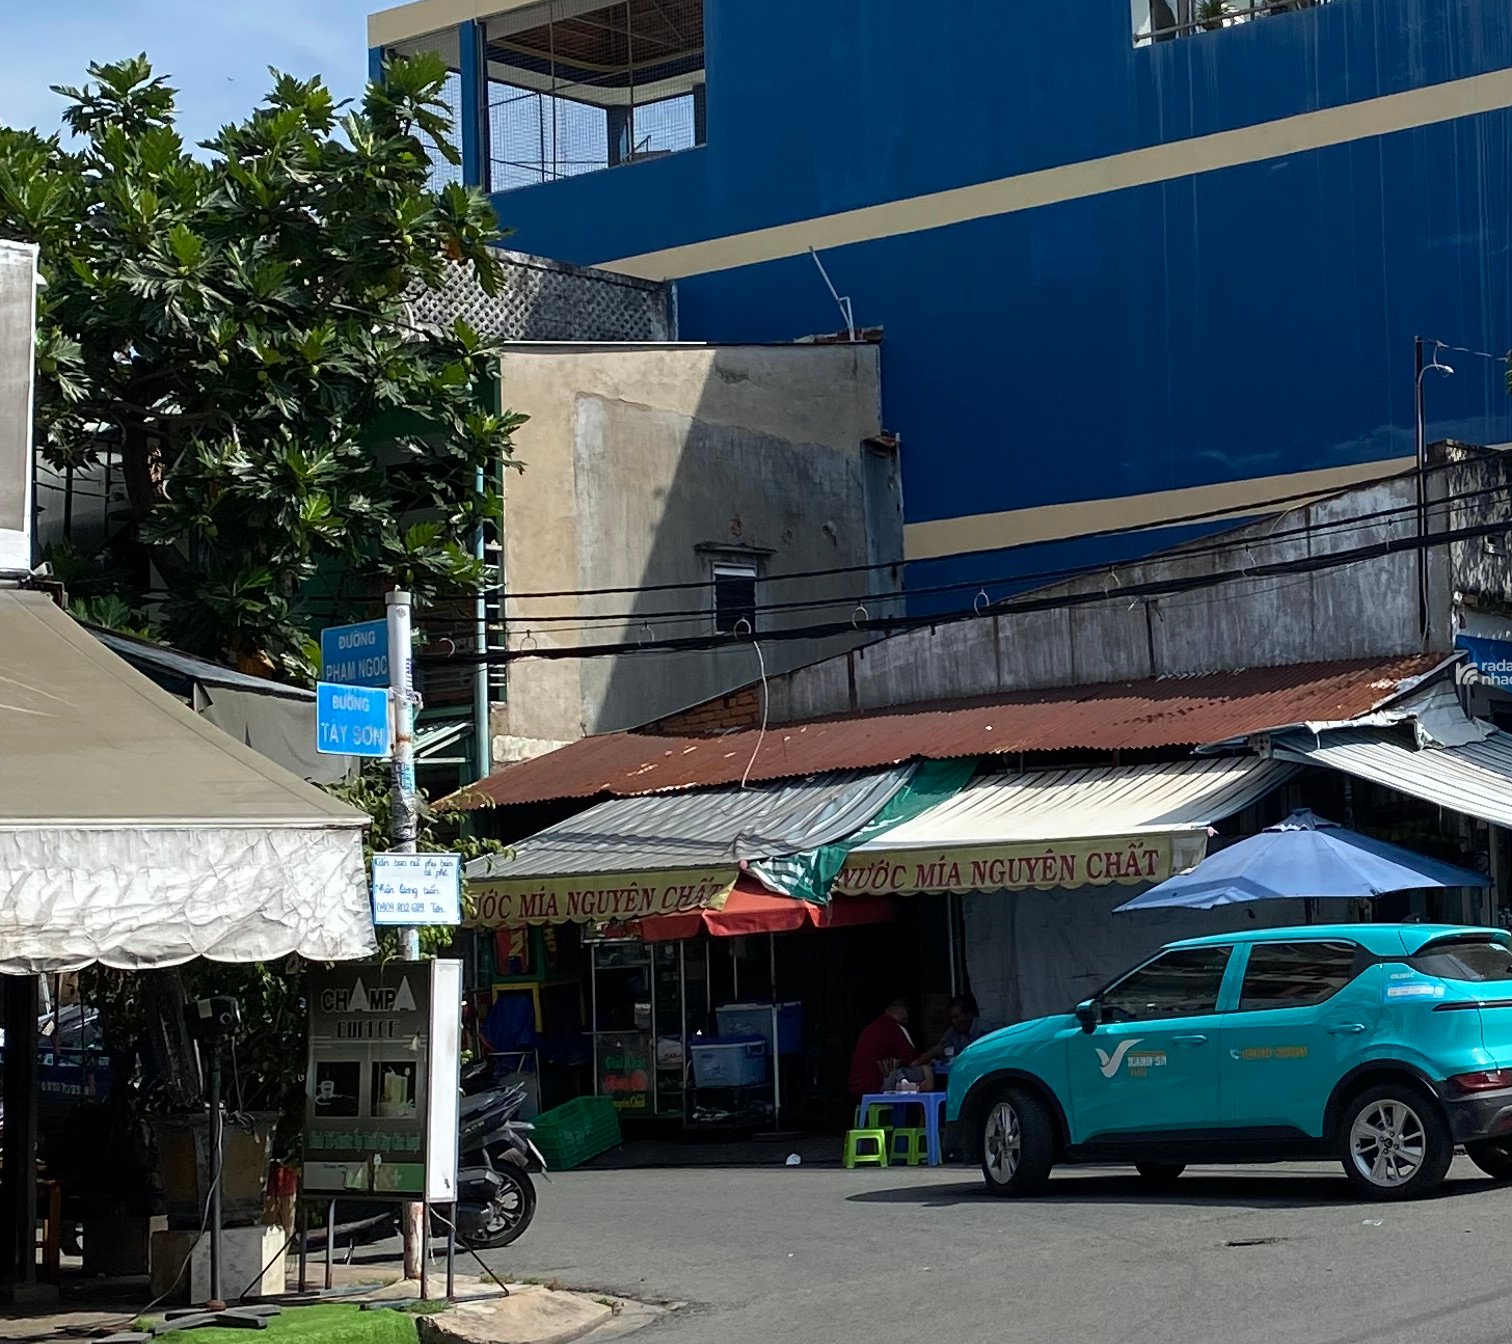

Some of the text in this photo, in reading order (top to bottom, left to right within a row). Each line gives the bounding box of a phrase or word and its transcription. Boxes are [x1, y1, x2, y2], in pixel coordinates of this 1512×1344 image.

[914, 854, 963, 889] MÍA
[970, 847, 1077, 885] NGUYÊN
[1085, 841, 1159, 879] CHẤT
[471, 888, 512, 920] ƯỚC
[518, 886, 558, 919] MÍA
[567, 882, 656, 916] NGUYÊN
[322, 975, 417, 1013] CHAMPA
